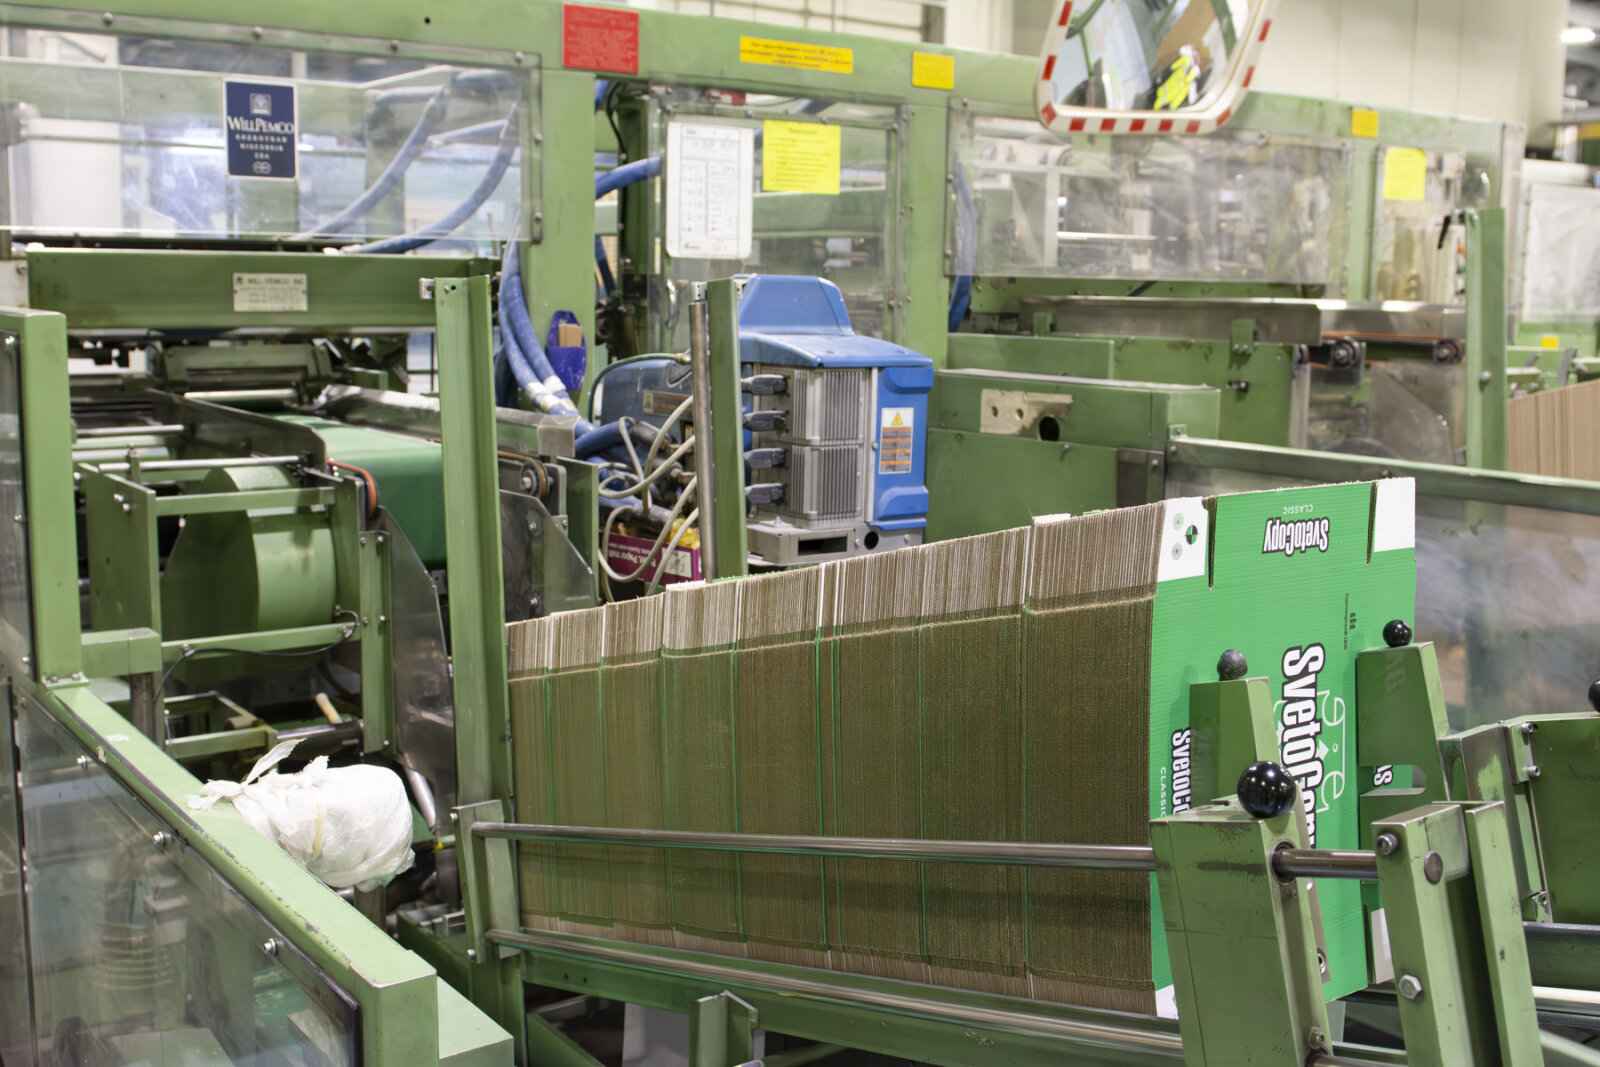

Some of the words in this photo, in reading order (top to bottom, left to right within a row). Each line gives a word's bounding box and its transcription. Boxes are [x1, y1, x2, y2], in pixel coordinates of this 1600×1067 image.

[1282, 504, 1314, 515] CLASSIC
[1262, 516, 1330, 557] SvetoCopy
[1281, 642, 1326, 850] SvetoC
